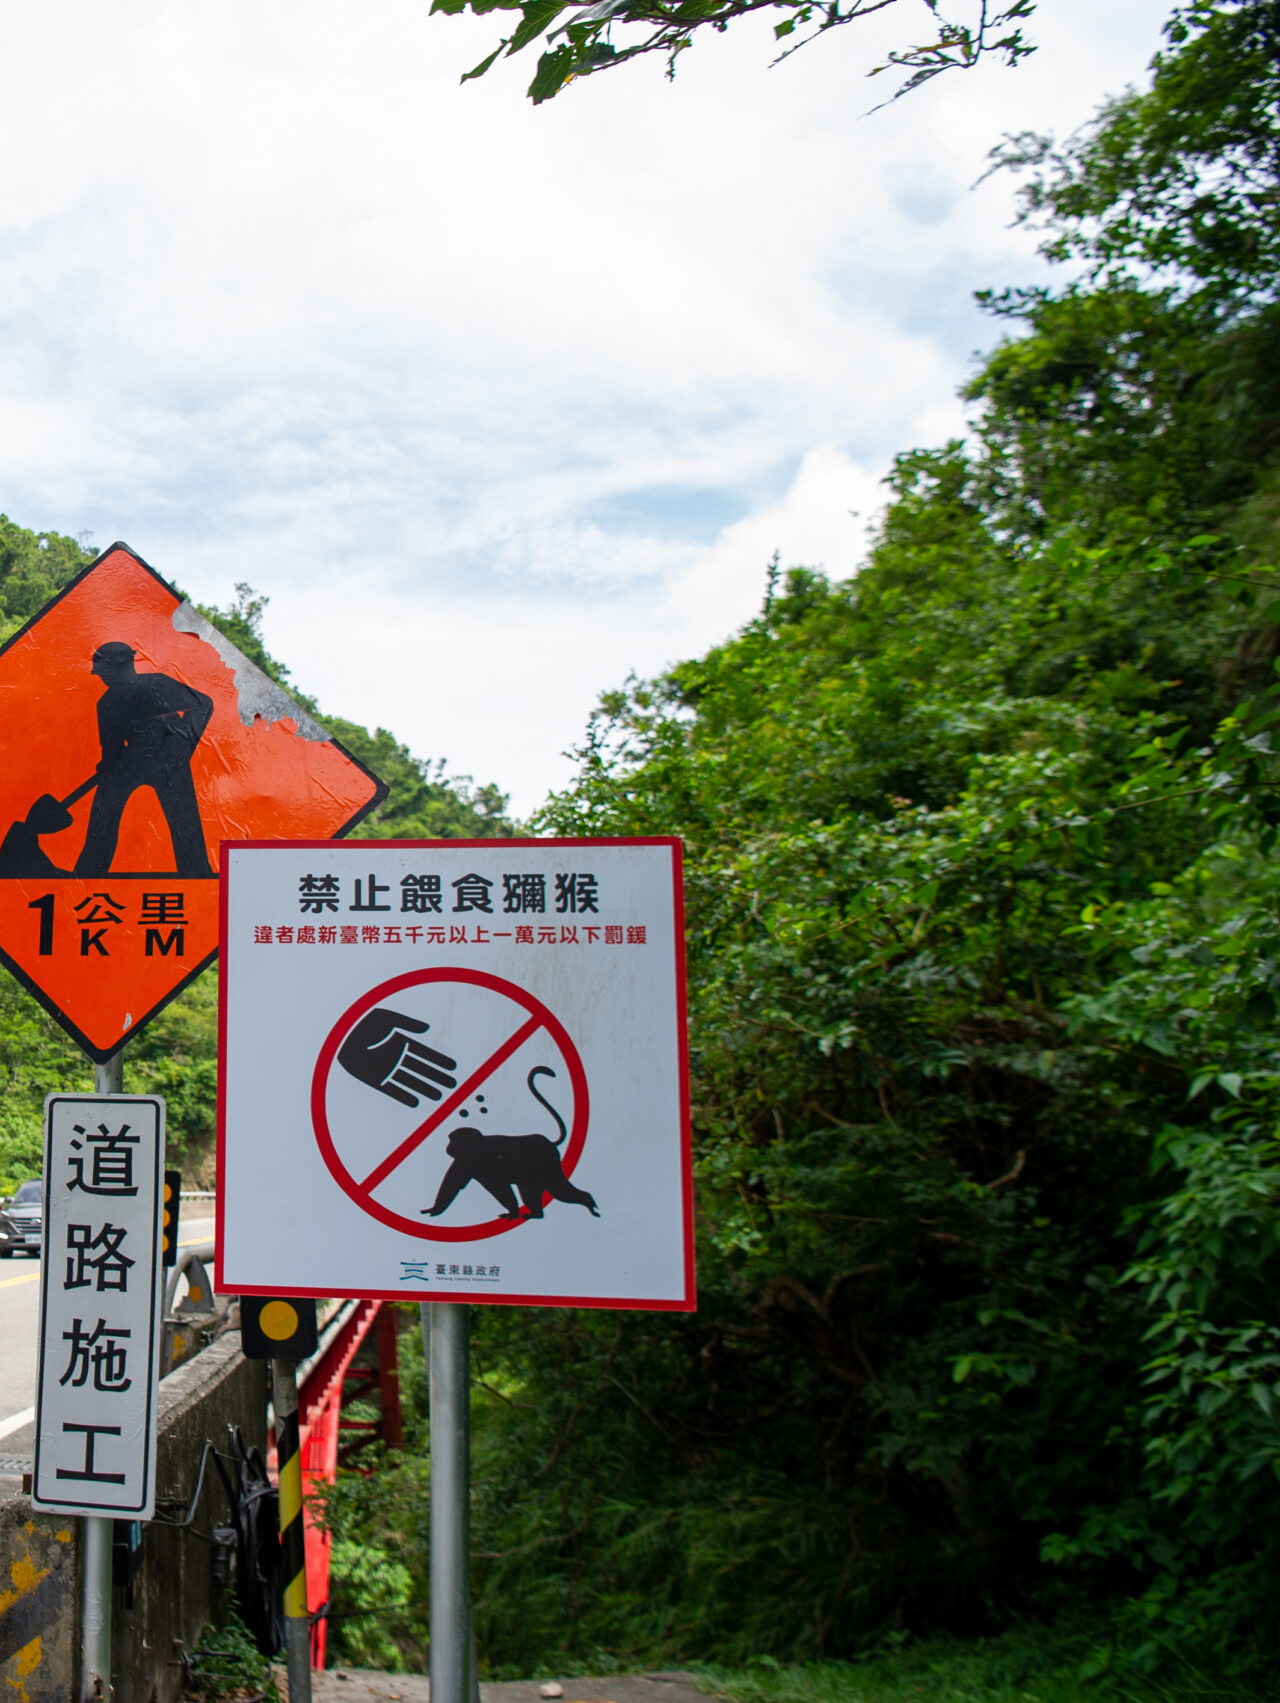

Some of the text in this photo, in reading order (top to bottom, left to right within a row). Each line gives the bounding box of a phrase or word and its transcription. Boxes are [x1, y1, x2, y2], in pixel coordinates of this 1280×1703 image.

[298, 873, 599, 914] 禁止餵食獼猴
[29, 893, 189, 956] 1 公里
[253, 925, 648, 945] 違者處新臺幣五千元以上一萬元以下罰鍰
[435, 1264, 501, 1277] 臺東縣政府
[56, 1122, 140, 1486] 道路施工
